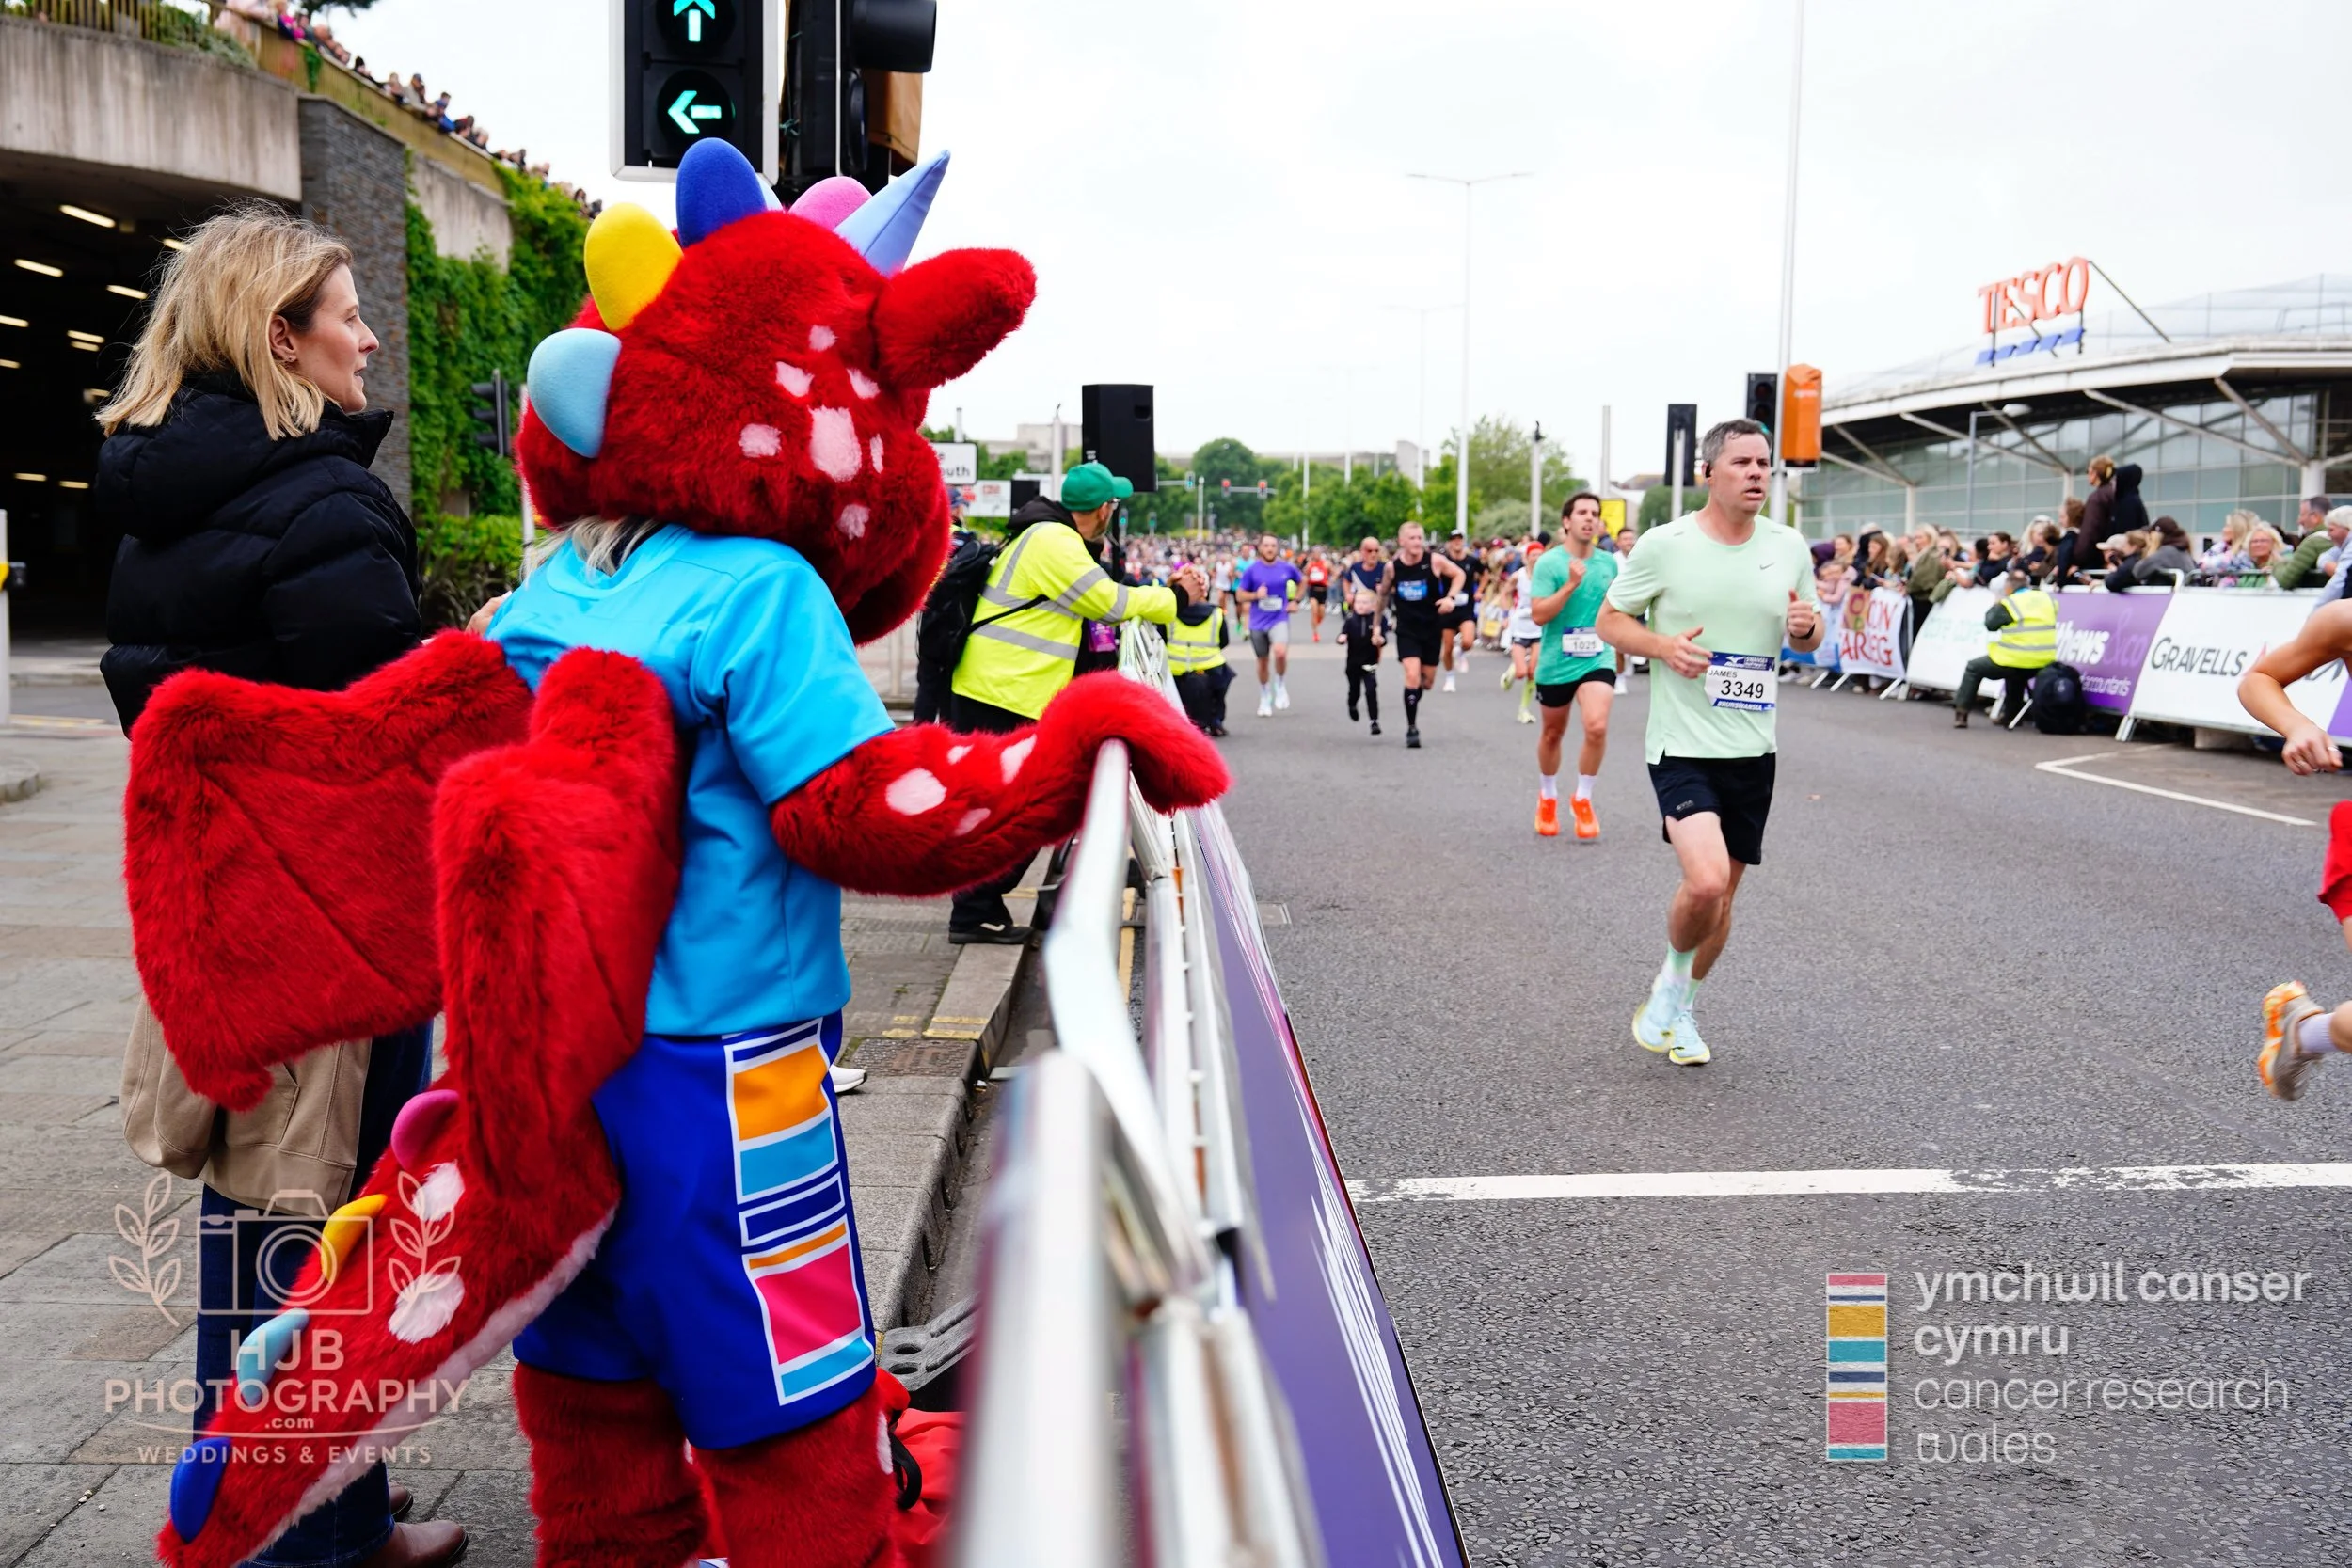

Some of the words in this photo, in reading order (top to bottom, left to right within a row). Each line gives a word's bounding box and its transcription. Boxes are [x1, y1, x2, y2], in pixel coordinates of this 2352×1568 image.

[1978, 256, 2089, 334] TESCO
[2151, 637, 2248, 677] GRAVELLS
[1708, 669, 1738, 679] JAMES
[1721, 679, 1764, 699] 3349
